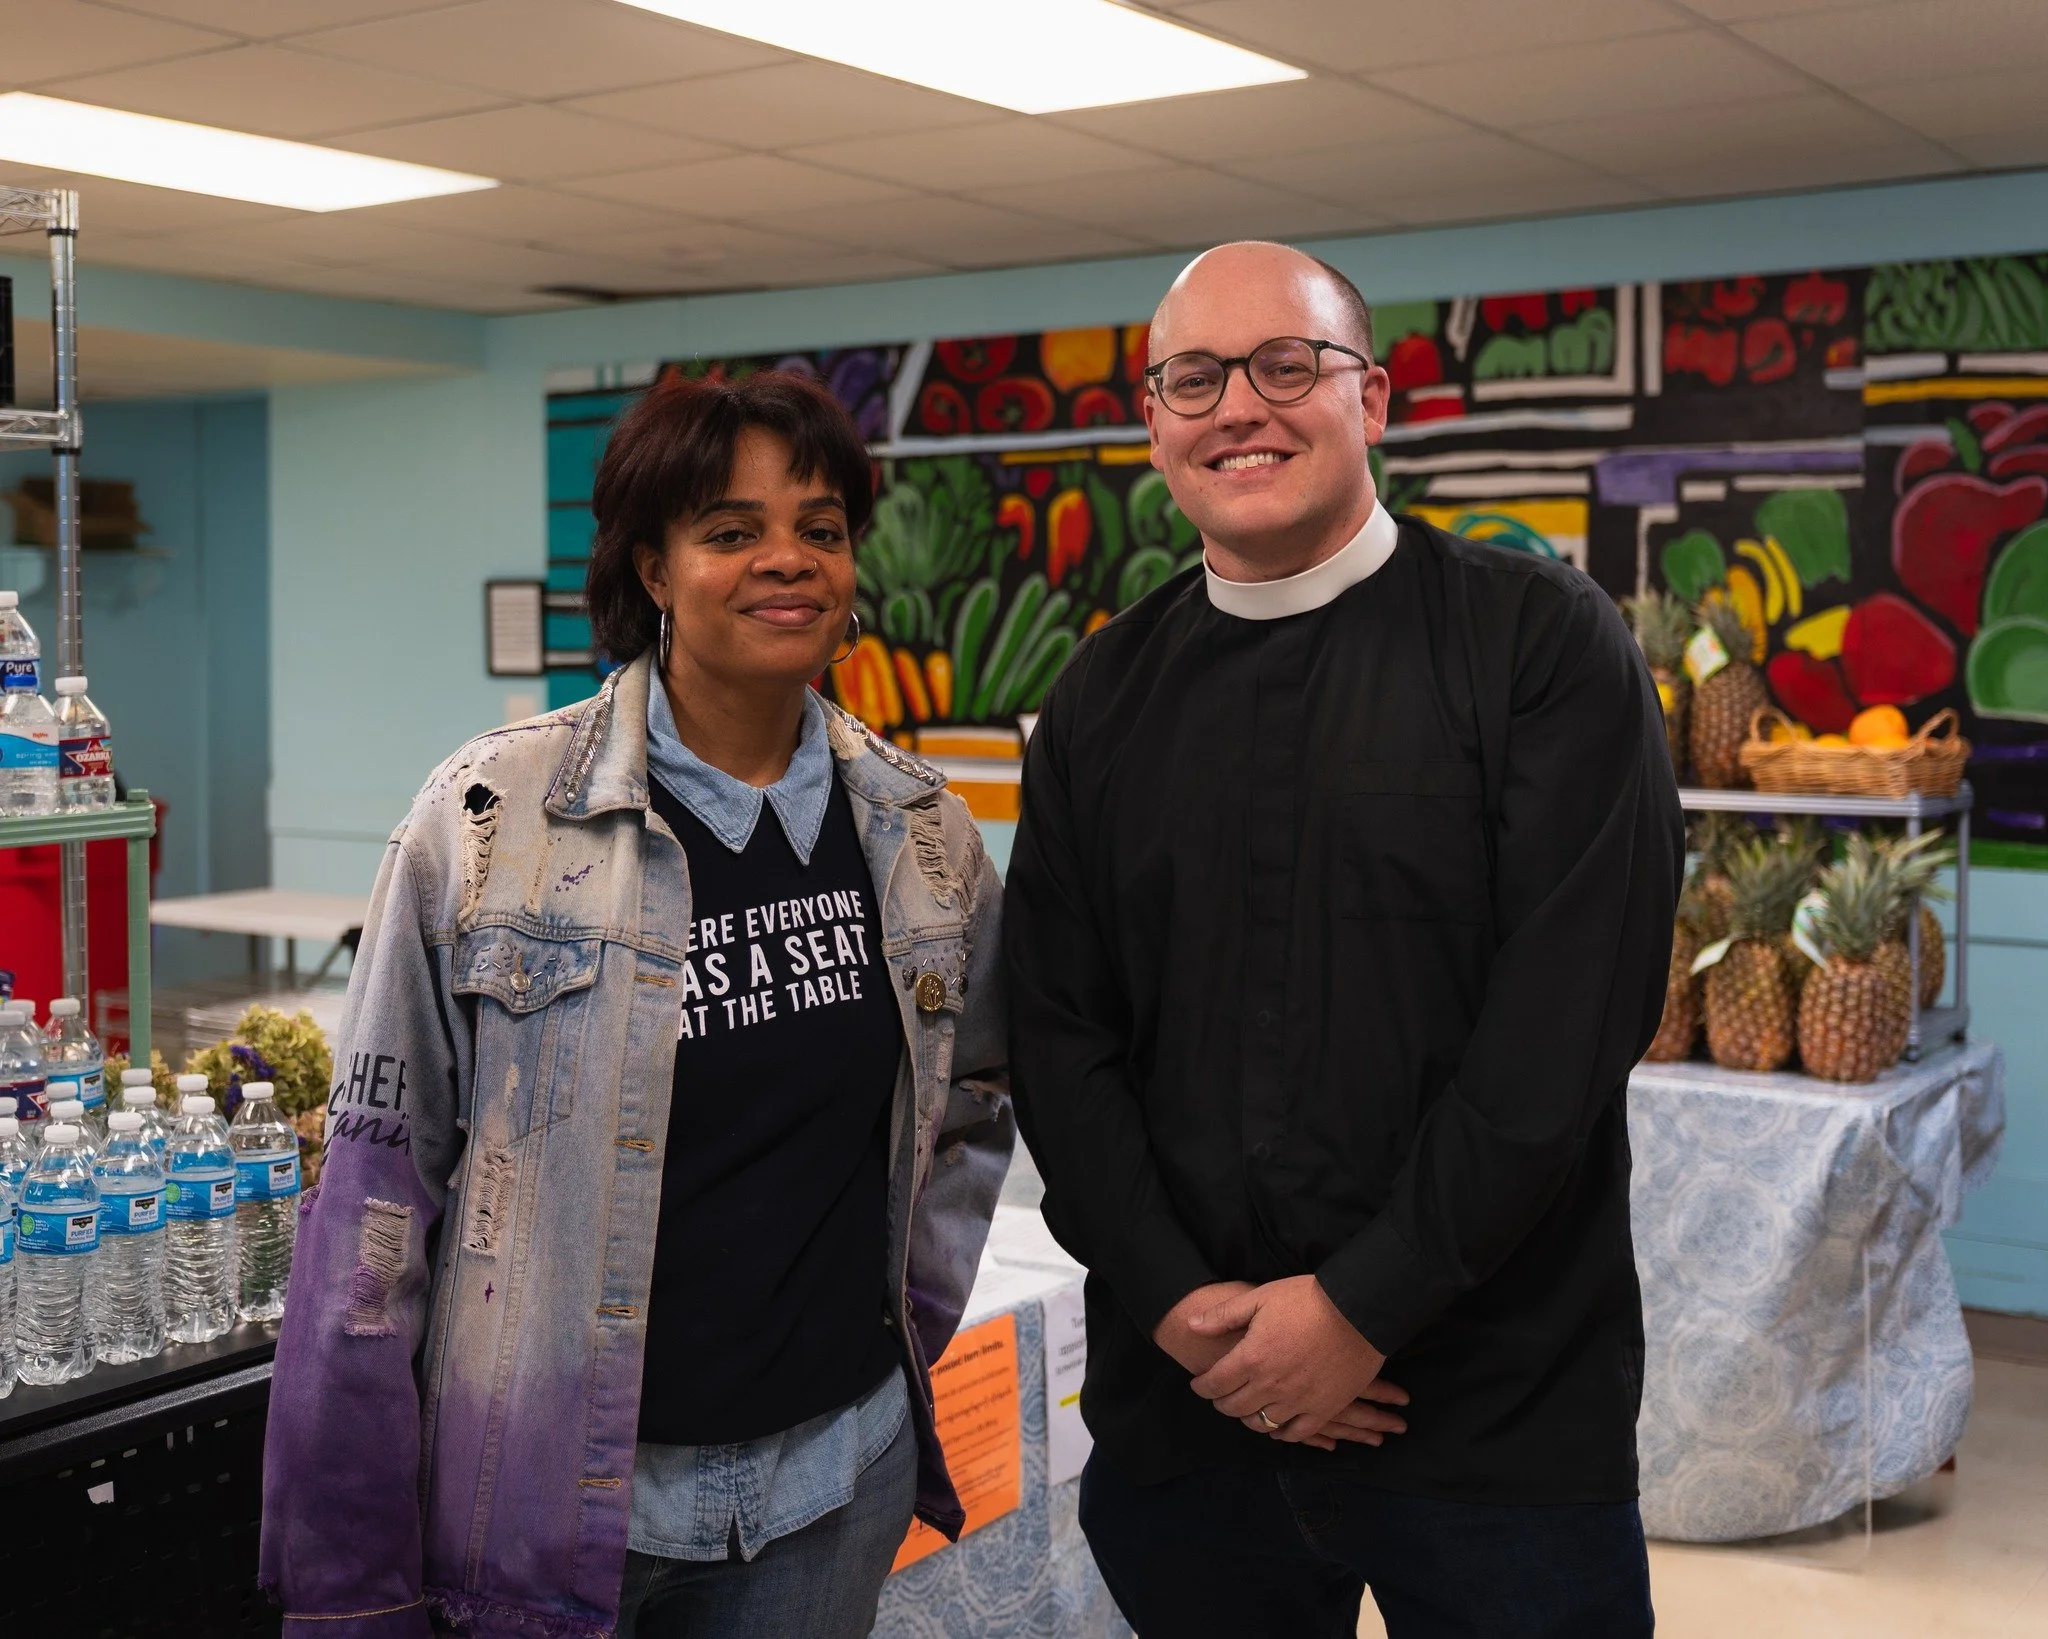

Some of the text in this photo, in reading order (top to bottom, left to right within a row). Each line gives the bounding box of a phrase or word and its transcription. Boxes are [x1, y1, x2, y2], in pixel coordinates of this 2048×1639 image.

[6, 661, 32, 674] Pure
[685, 890, 865, 953] ERE EVERYONE
[682, 924, 869, 1003] AS A SEAT
[678, 970, 863, 1040] AT THE TABLE
[71, 1228, 94, 1237] PURIFIED
